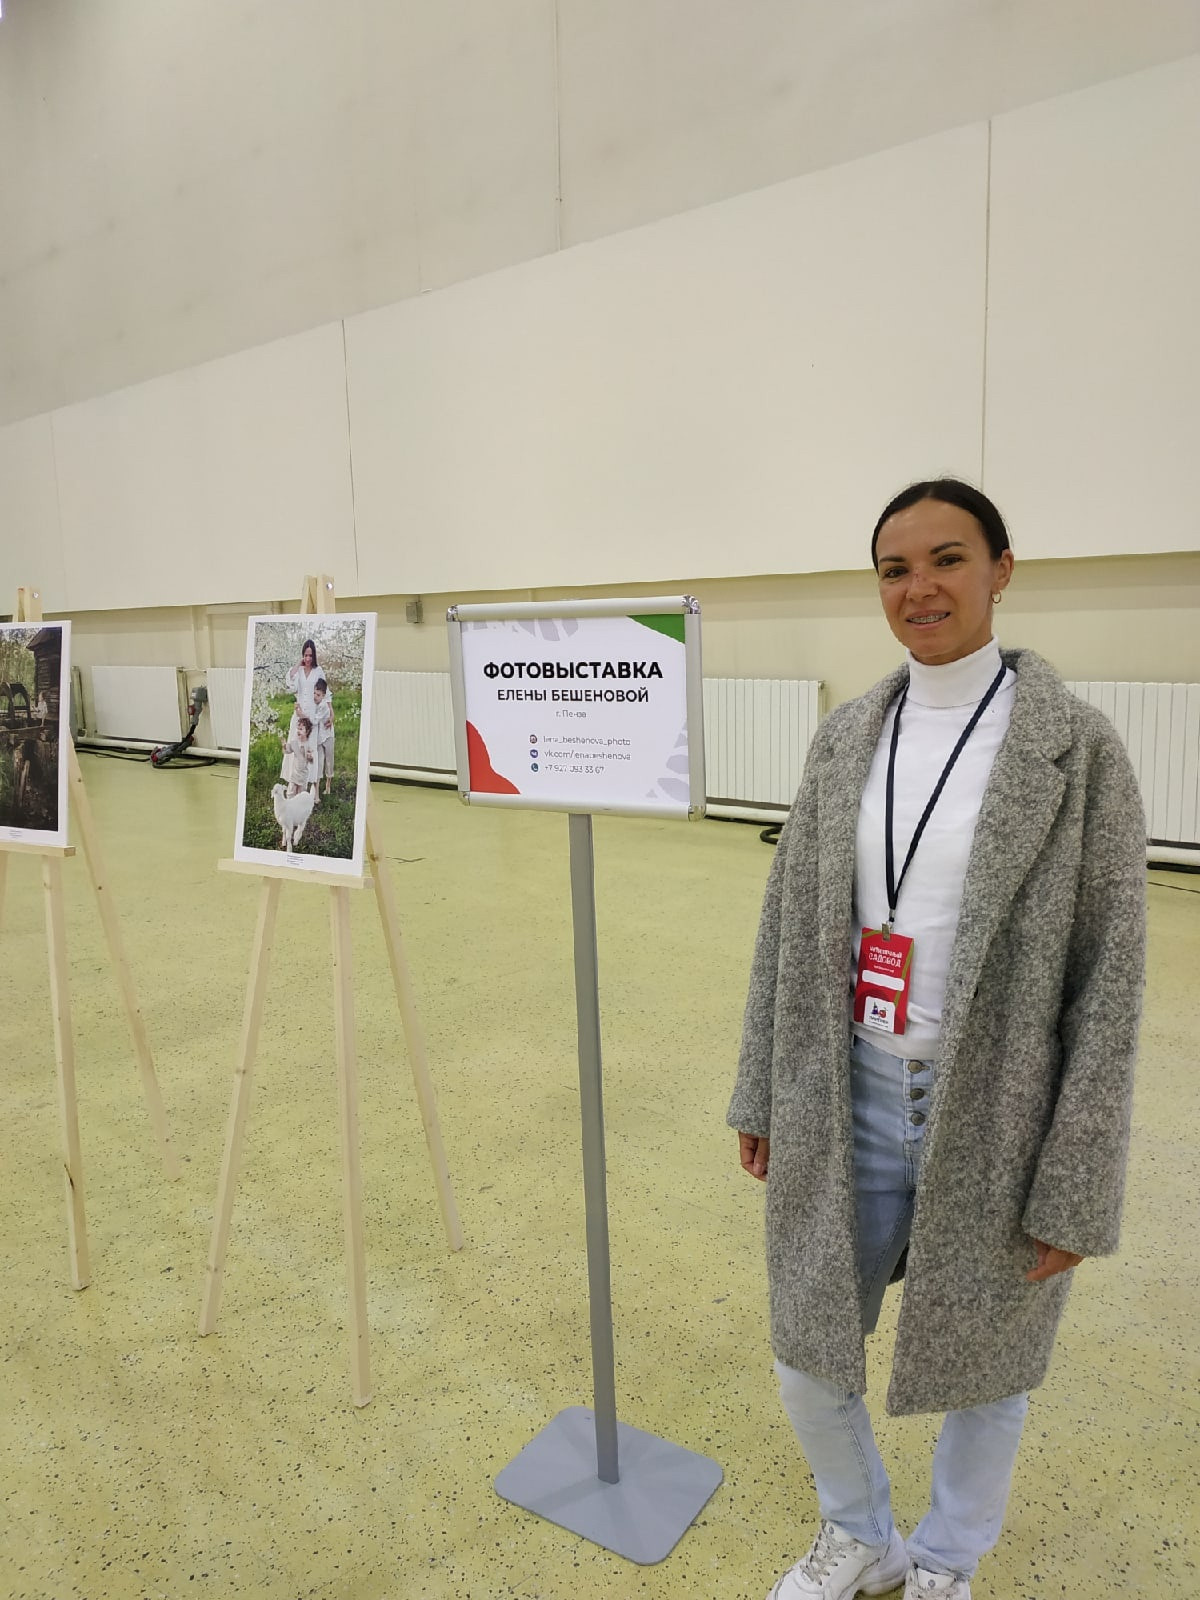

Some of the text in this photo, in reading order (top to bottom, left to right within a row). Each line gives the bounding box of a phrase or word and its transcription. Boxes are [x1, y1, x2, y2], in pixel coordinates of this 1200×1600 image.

[483, 661, 664, 679] ФОТОВЫСТАВКА
[497, 687, 649, 702] ЕЛЕНЫ БЕШЕНОВОЙ
